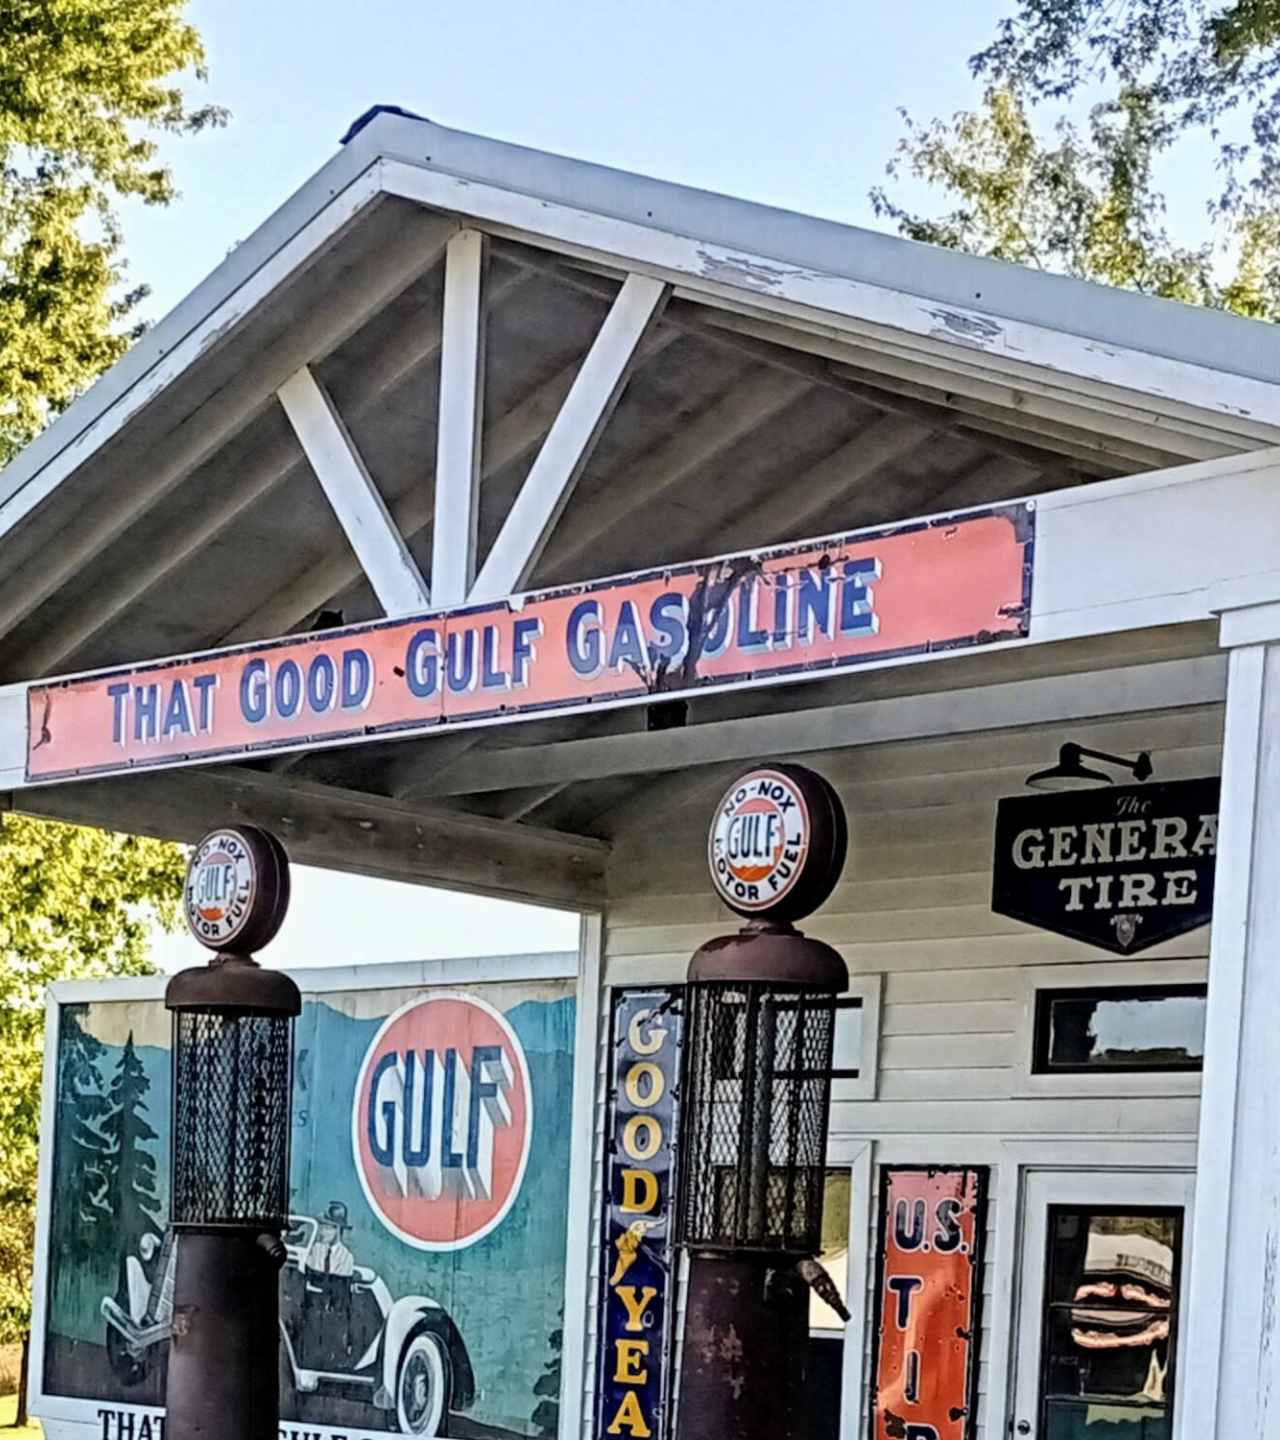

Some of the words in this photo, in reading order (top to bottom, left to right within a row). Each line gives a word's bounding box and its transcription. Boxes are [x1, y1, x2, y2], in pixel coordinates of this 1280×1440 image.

[107, 673, 218, 748] THAT
[239, 647, 375, 725] GOOD
[405, 617, 544, 698] GULF
[567, 556, 882, 681] GASOLINE
[724, 781, 796, 818] NO-NOX
[728, 814, 777, 859] GULF
[768, 833, 801, 892] FUEL
[1011, 814, 1218, 870] GENERA
[225, 881, 250, 928] FUEL
[1058, 869, 1198, 911] TIRE
[368, 1045, 514, 1196] GULF
[891, 1197, 970, 1256] U.S.
